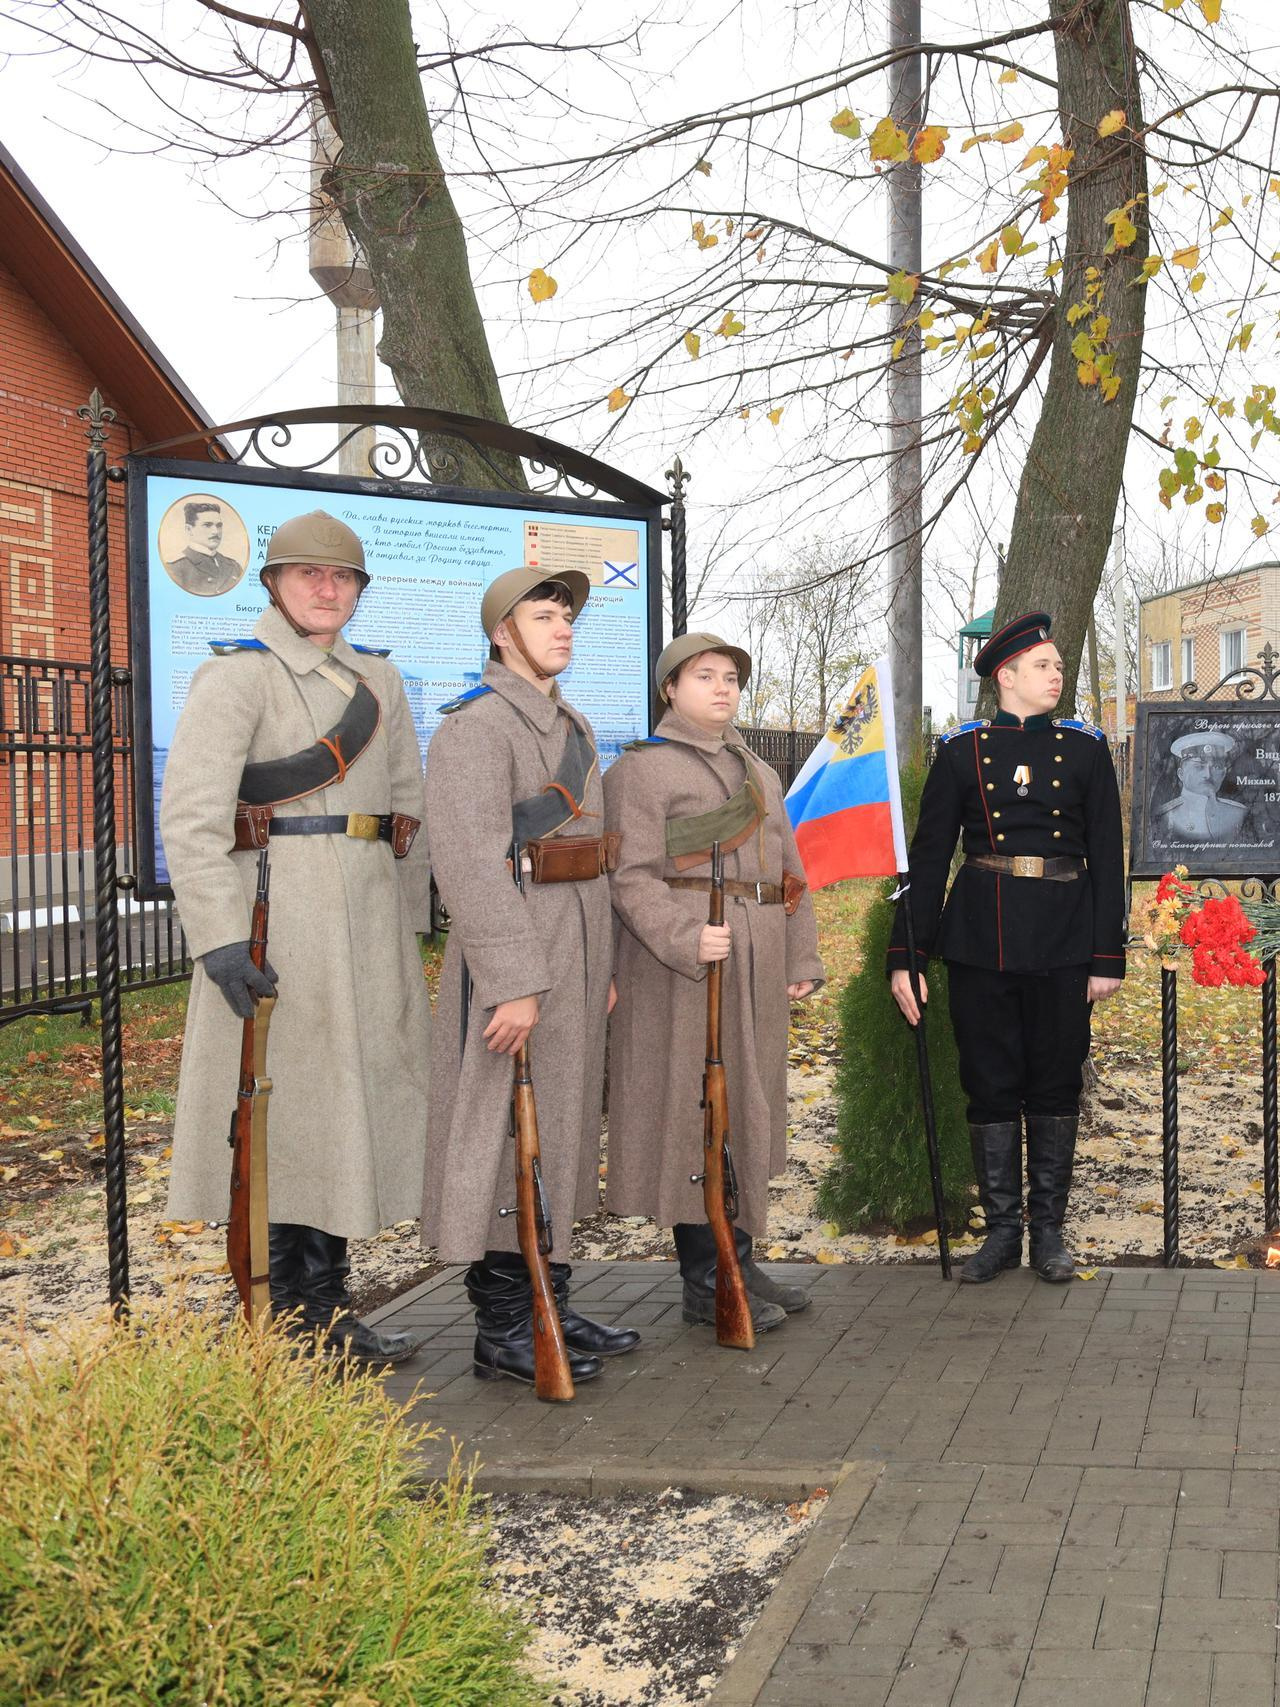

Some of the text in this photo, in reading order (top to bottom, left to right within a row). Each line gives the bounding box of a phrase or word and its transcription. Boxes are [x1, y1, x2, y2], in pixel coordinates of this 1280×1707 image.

[362, 513, 388, 522] слава
[390, 516, 424, 525] русских
[425, 519, 462, 528] моряков
[372, 525, 381, 534] В
[383, 528, 422, 538] историю
[374, 538, 392, 547] кто
[423, 541, 457, 552] Россию
[375, 551, 414, 561] отдавал
[415, 556, 426, 564] за
[428, 553, 462, 565] Родину
[377, 575, 418, 584] перерыве
[420, 578, 446, 587] между
[448, 579, 483, 588] войнами
[431, 680, 467, 689] мировой
[1236, 775, 1276, 786] Михаил
[1151, 839, 1275, 852] От благодарных потомков
